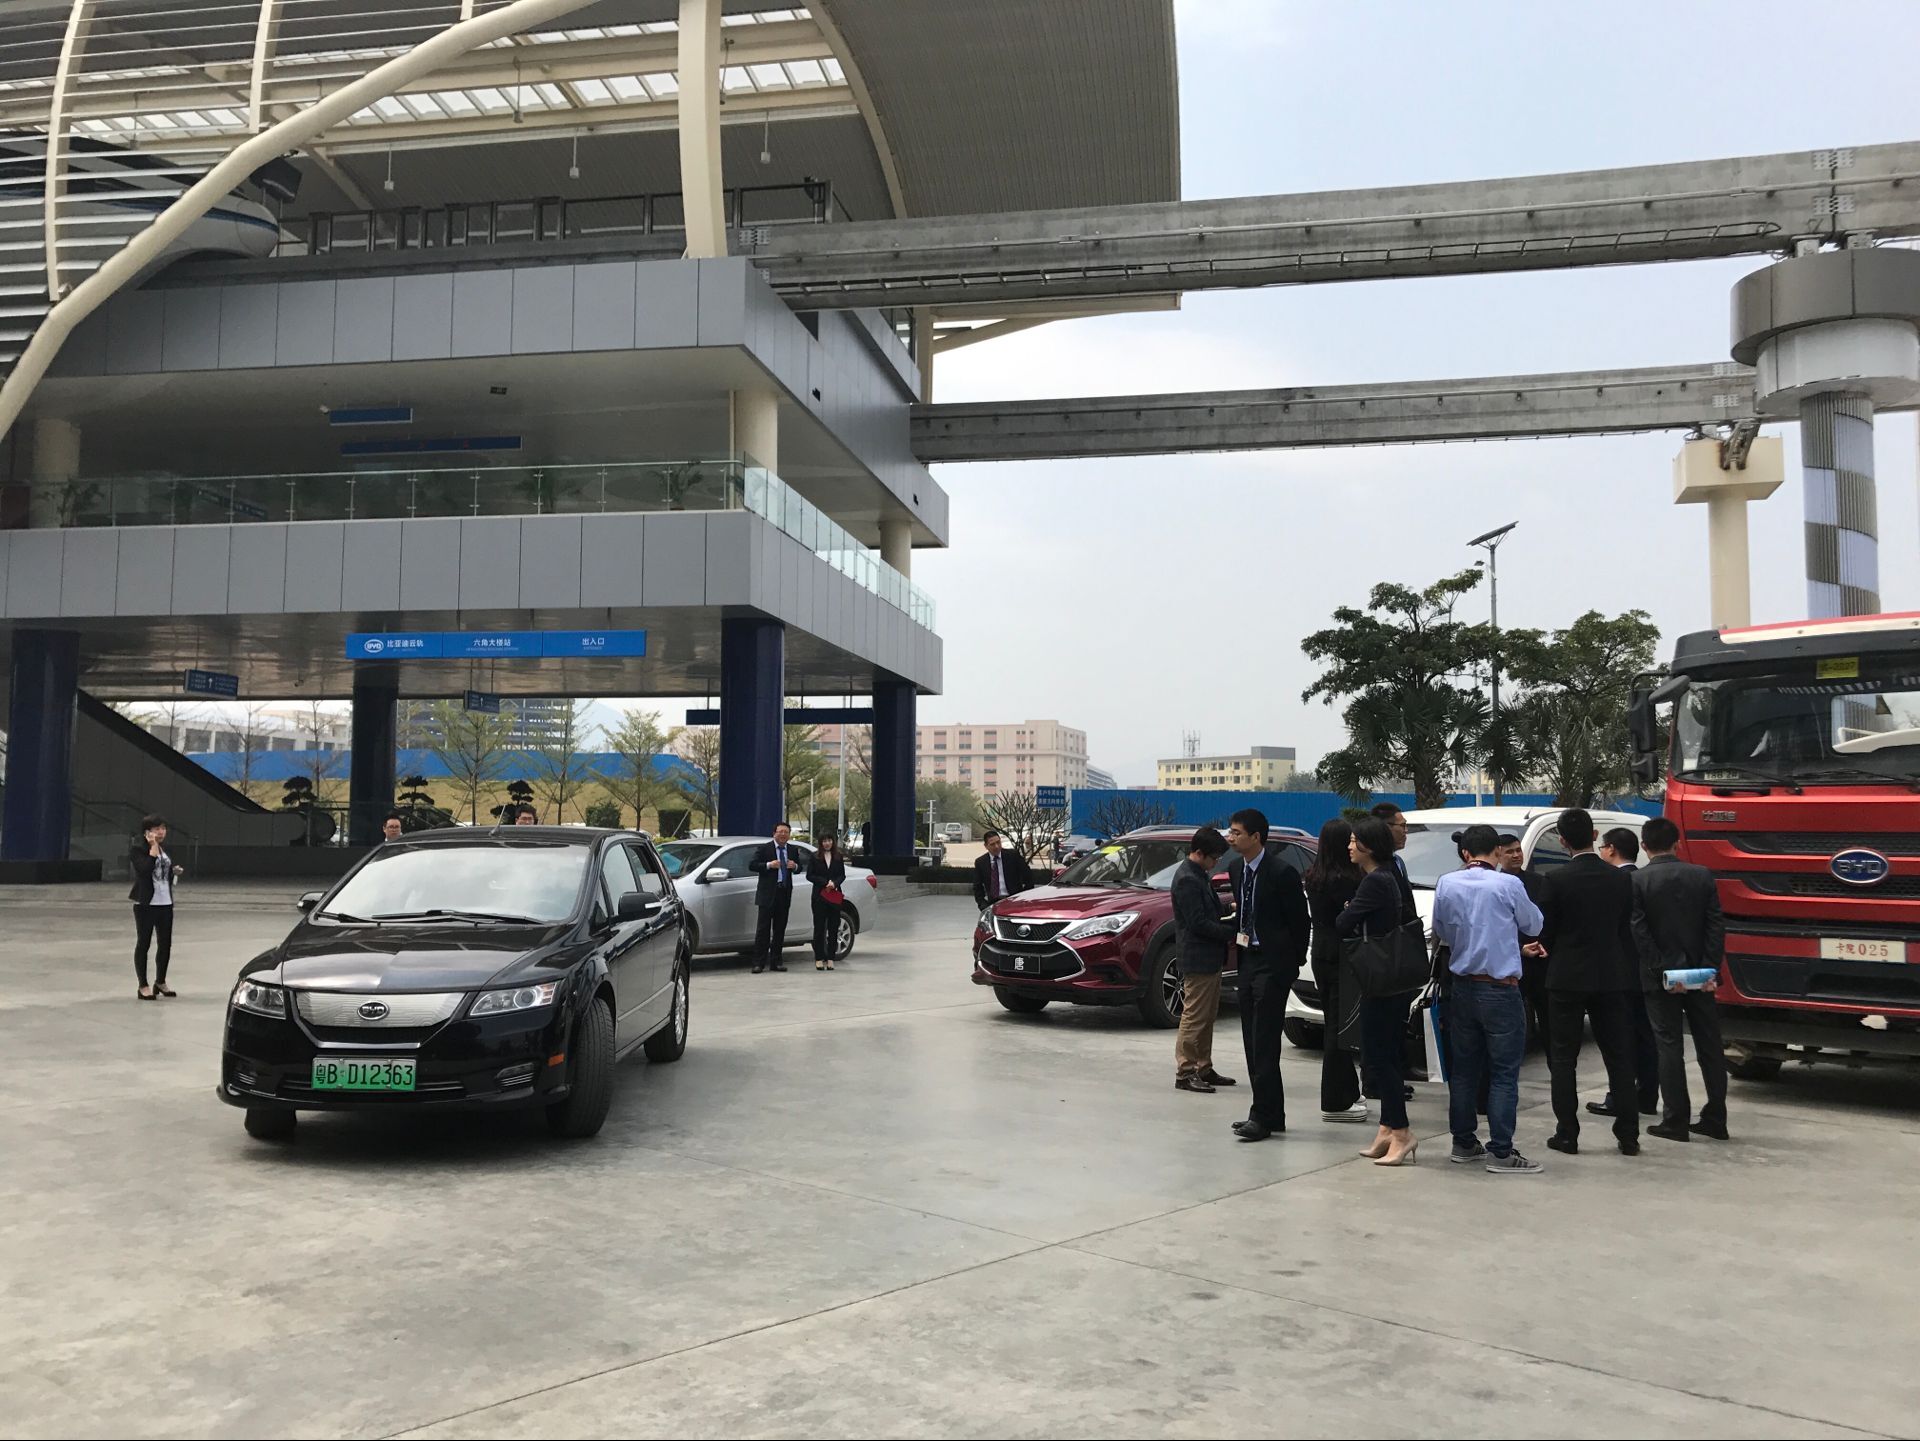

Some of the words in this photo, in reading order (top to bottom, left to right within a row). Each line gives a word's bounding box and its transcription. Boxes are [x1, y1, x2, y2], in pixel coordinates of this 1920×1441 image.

[472, 638, 512, 647] 六角大楼站
[581, 637, 605, 646] 出入口
[1836, 859, 1882, 874] BYD
[1014, 956, 1025, 970] 唐
[347, 1063, 413, 1086] D12363
